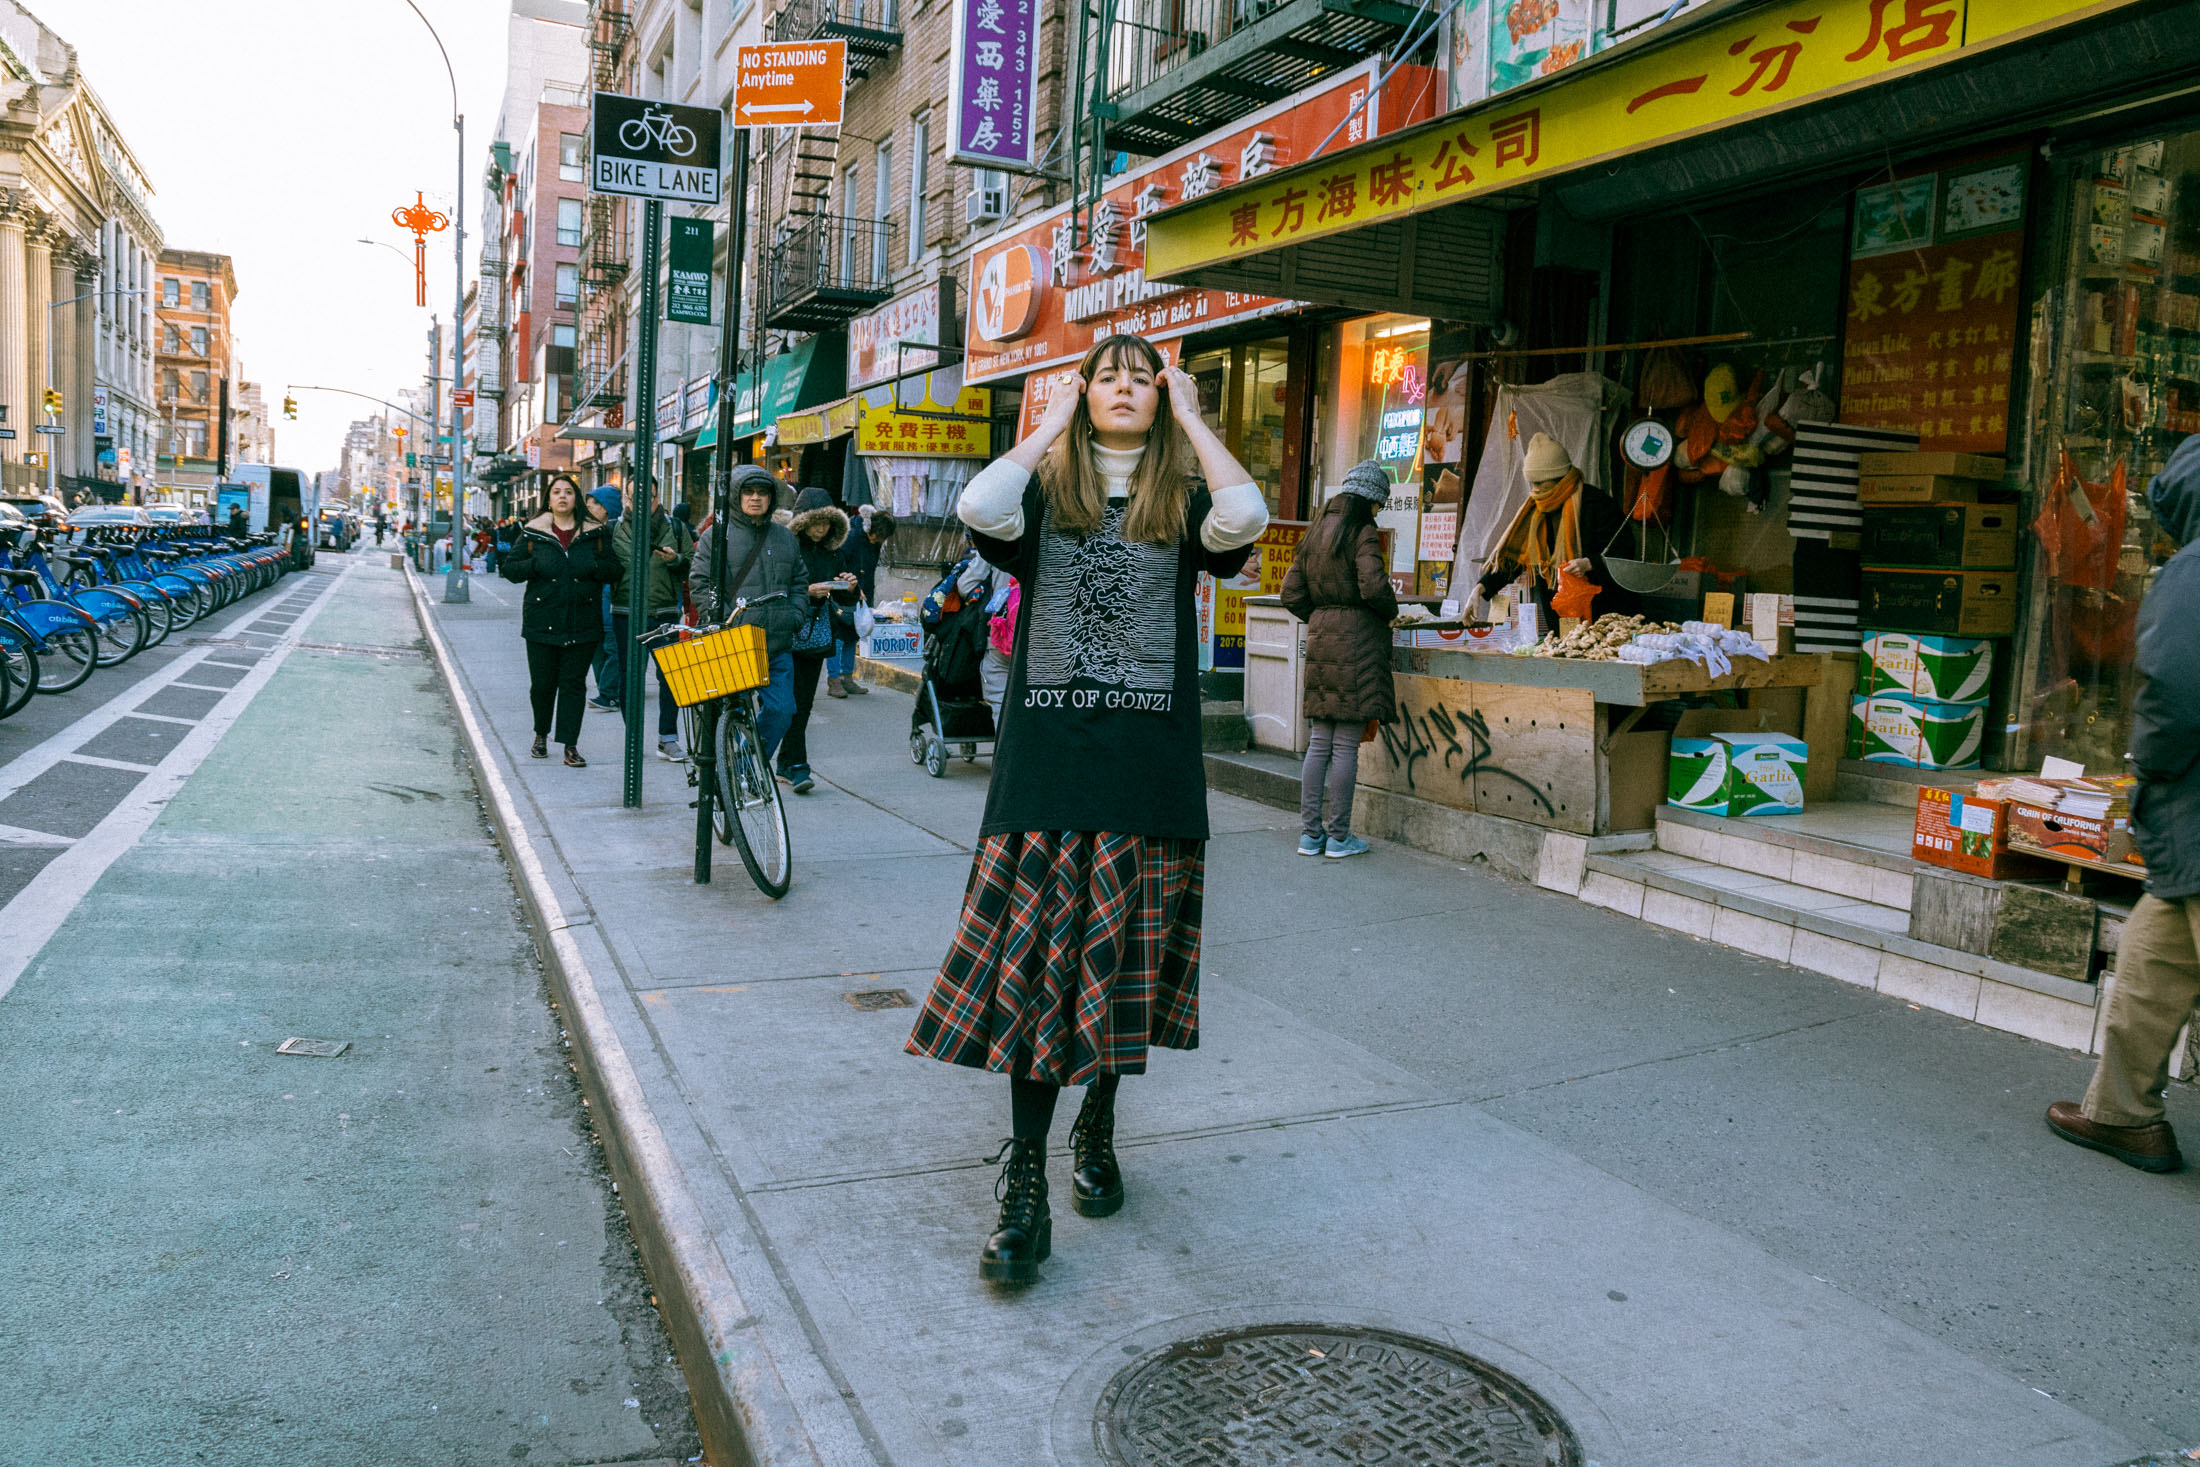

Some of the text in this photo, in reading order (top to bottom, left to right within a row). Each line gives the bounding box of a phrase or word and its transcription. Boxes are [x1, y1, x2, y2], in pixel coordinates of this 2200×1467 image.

[742, 50, 827, 68] NO STANDING
[742, 70, 795, 90] Anytime
[601, 160, 713, 194] BIKE LANE
[1229, 107, 1541, 247] 東方海味公司
[684, 226, 699, 236] 211
[672, 270, 709, 281] KAMWO
[1064, 278, 1109, 323] MINH
[1150, 305, 1168, 330] TÂY
[1171, 299, 1192, 324] BÁC
[1195, 292, 1208, 317] ÁI
[1000, 352, 1010, 366] NEW
[1025, 345, 1032, 360] NY
[875, 422, 967, 440] 免費手機
[1225, 596, 1237, 609] 10
[1224, 612, 1236, 624] 60
[873, 638, 918, 652] NORDIC
[1219, 637, 1234, 648] 207
[1874, 656, 1926, 672] Garlic
[1024, 689, 1171, 712] JOY OF GONZ!
[1866, 720, 1921, 737] Garlic
[1744, 768, 1796, 784] Garlic
[2042, 812, 2052, 821] OF
[2053, 815, 2102, 832] CALIFORNIA
